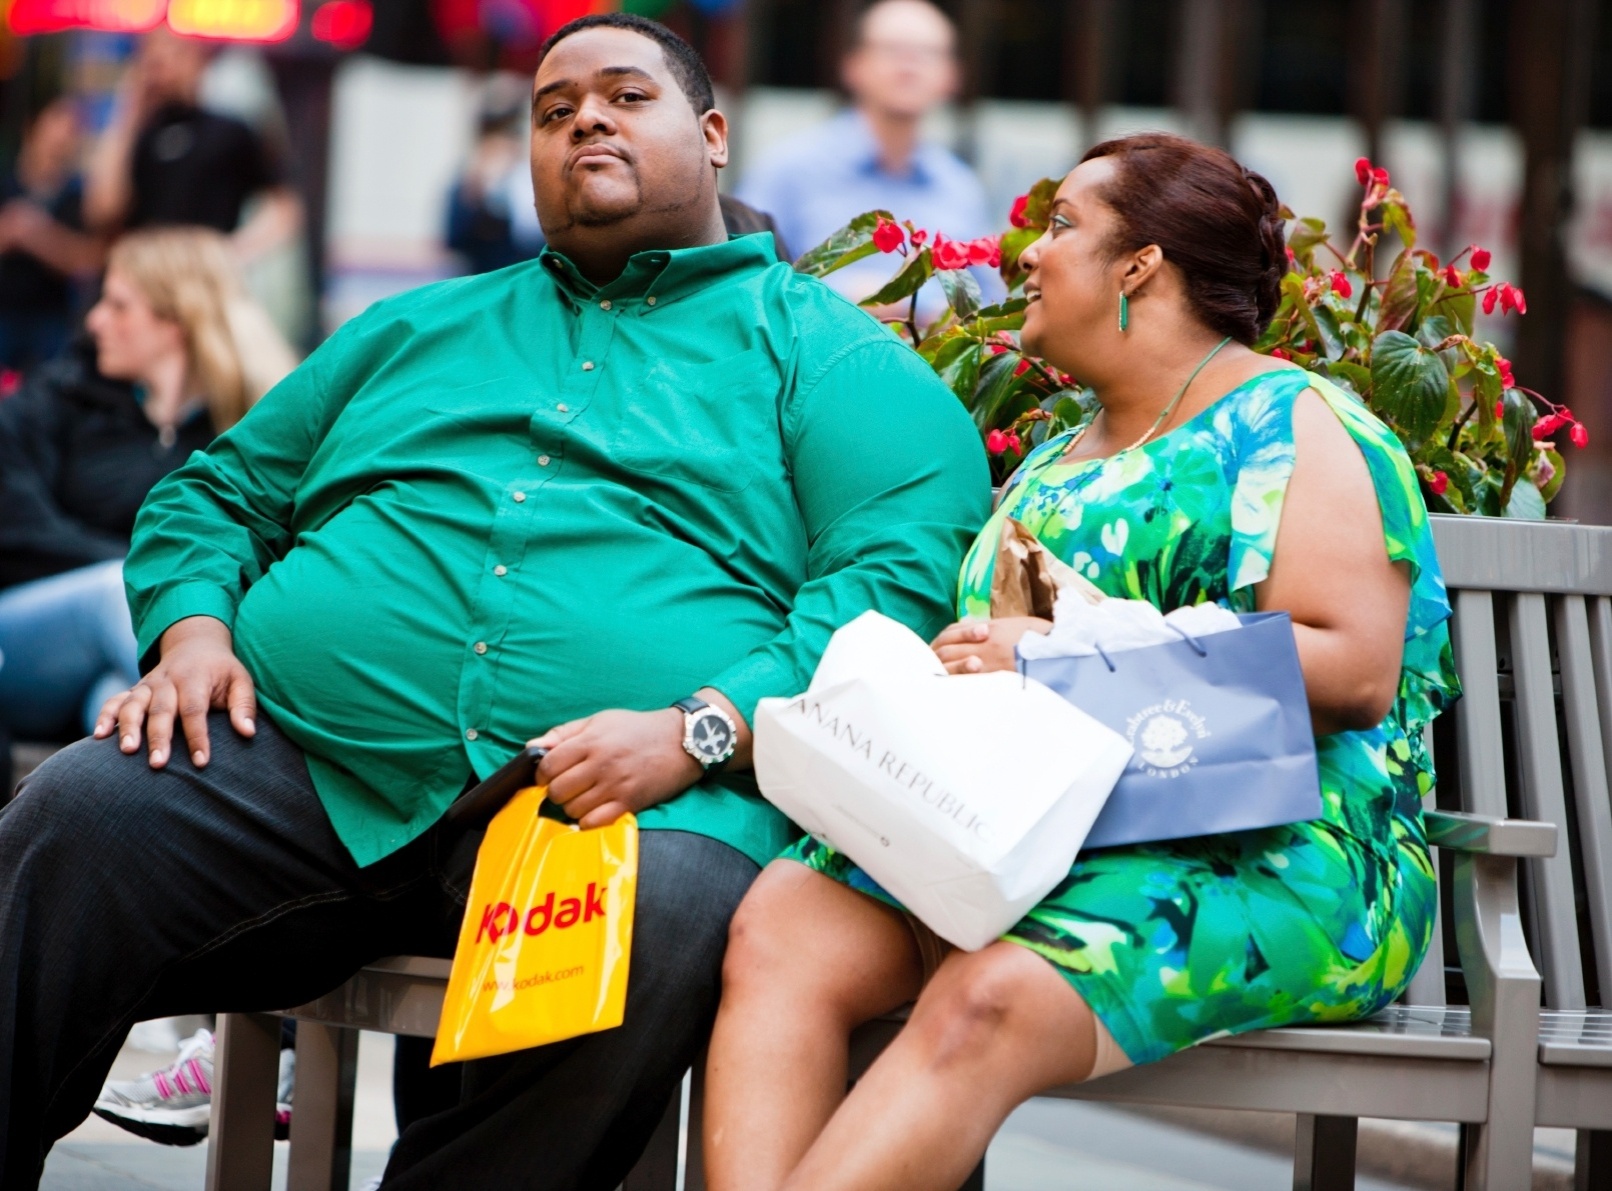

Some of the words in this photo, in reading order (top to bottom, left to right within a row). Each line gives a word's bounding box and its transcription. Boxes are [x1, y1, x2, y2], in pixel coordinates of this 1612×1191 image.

[786, 698, 873, 760] ANANA
[878, 750, 993, 844] REPUBLIC
[474, 881, 609, 945] Kodak
